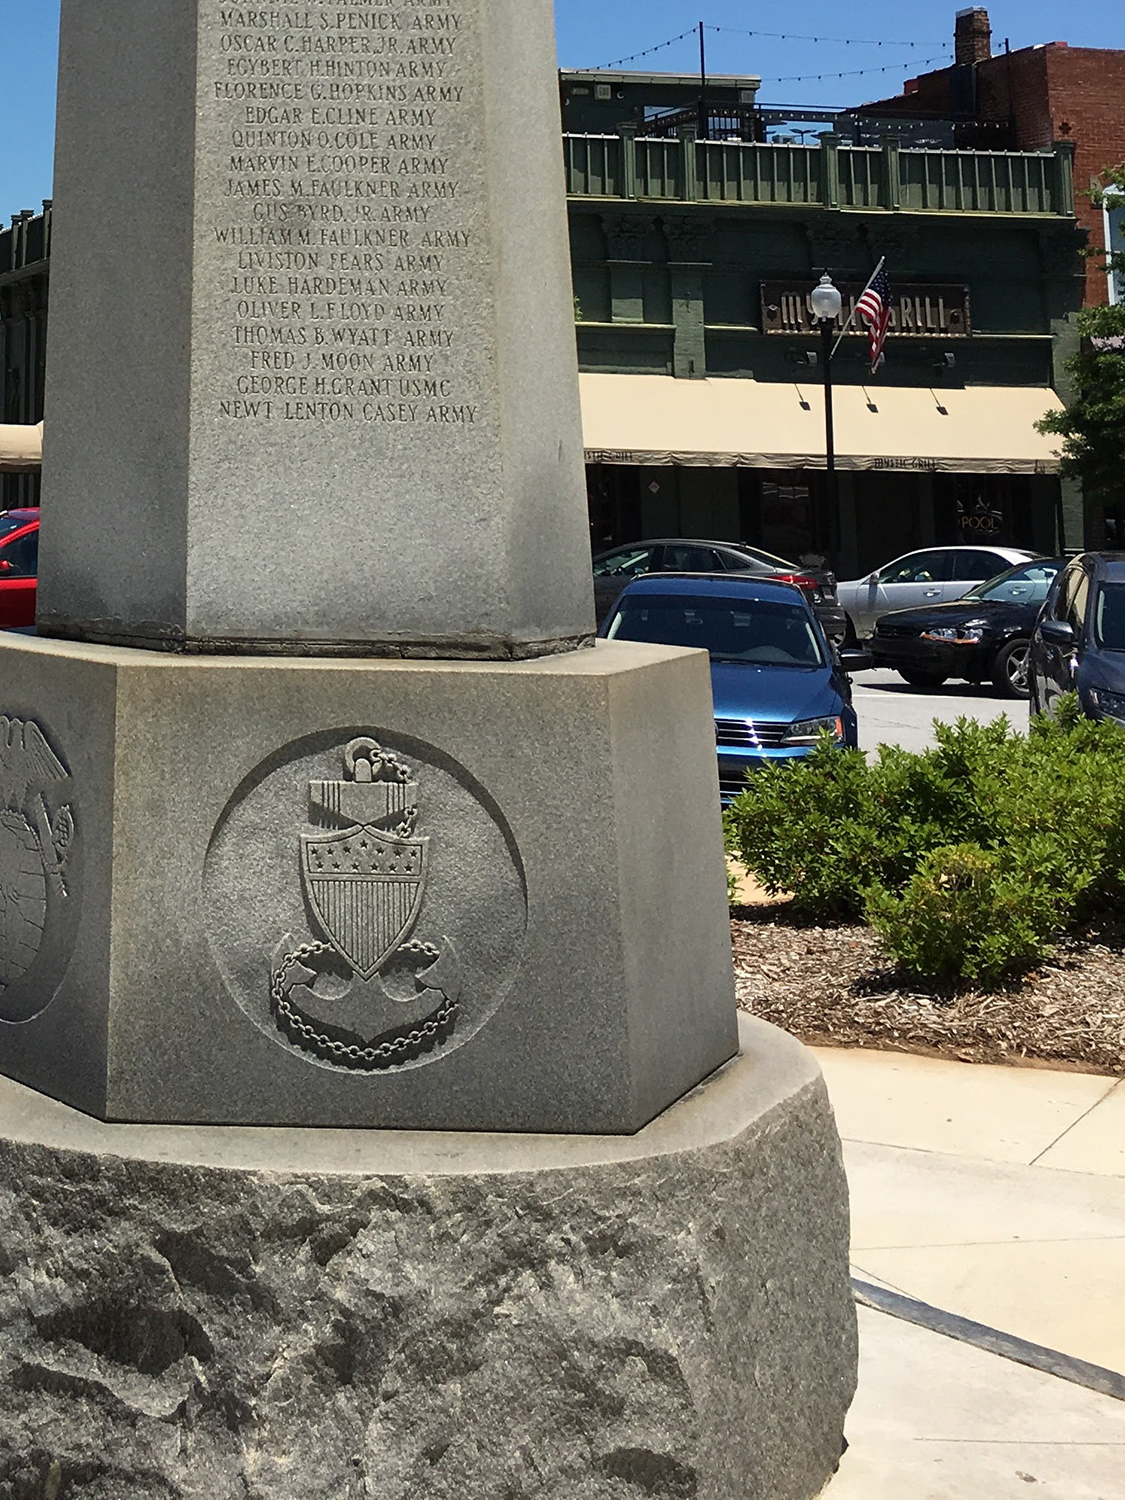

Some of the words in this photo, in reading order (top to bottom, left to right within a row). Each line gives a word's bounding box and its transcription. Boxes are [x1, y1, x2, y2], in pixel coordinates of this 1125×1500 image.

[412, 14, 462, 31] ARMY
[221, 35, 276, 52] OSCAR
[407, 38, 457, 54] ARMY
[395, 61, 447, 79] ARMY
[214, 82, 302, 100] FLORENCE
[414, 86, 464, 102] ARMY
[245, 107, 302, 125] EDGAR
[385, 109, 437, 126] ARMY
[232, 130, 312, 148] QUINTON
[386, 133, 437, 150] ARMY
[229, 155, 298, 173] MARVIN
[397, 158, 449, 175] ARMY
[224, 179, 280, 198] JAMES
[407, 181, 459, 199] ARMY
[381, 206, 431, 224] ARMY
[214, 227, 292, 245] WILLIAM
[420, 229, 472, 248] ARMY
[330, 253, 384, 271] FEARS
[394, 254, 444, 272] ARMY
[288, 277, 389, 296] HARDEMAN
[396, 279, 447, 297] ARMY
[238, 301, 301, 319] OLIVER
[393, 303, 445, 322] ARMY
[232, 326, 307, 345] THOMAS
[403, 328, 454, 347] ARMY
[251, 351, 295, 370] FRED
[383, 354, 434, 372] ARMY
[237, 376, 308, 395] GEORGE
[400, 378, 451, 397] USMC
[220, 401, 273, 419] NEWT
[285, 402, 354, 421] LENTON
[363, 403, 418, 422] CASEY
[426, 404, 477, 424] ARMY
[962, 516, 998, 530] POOL
